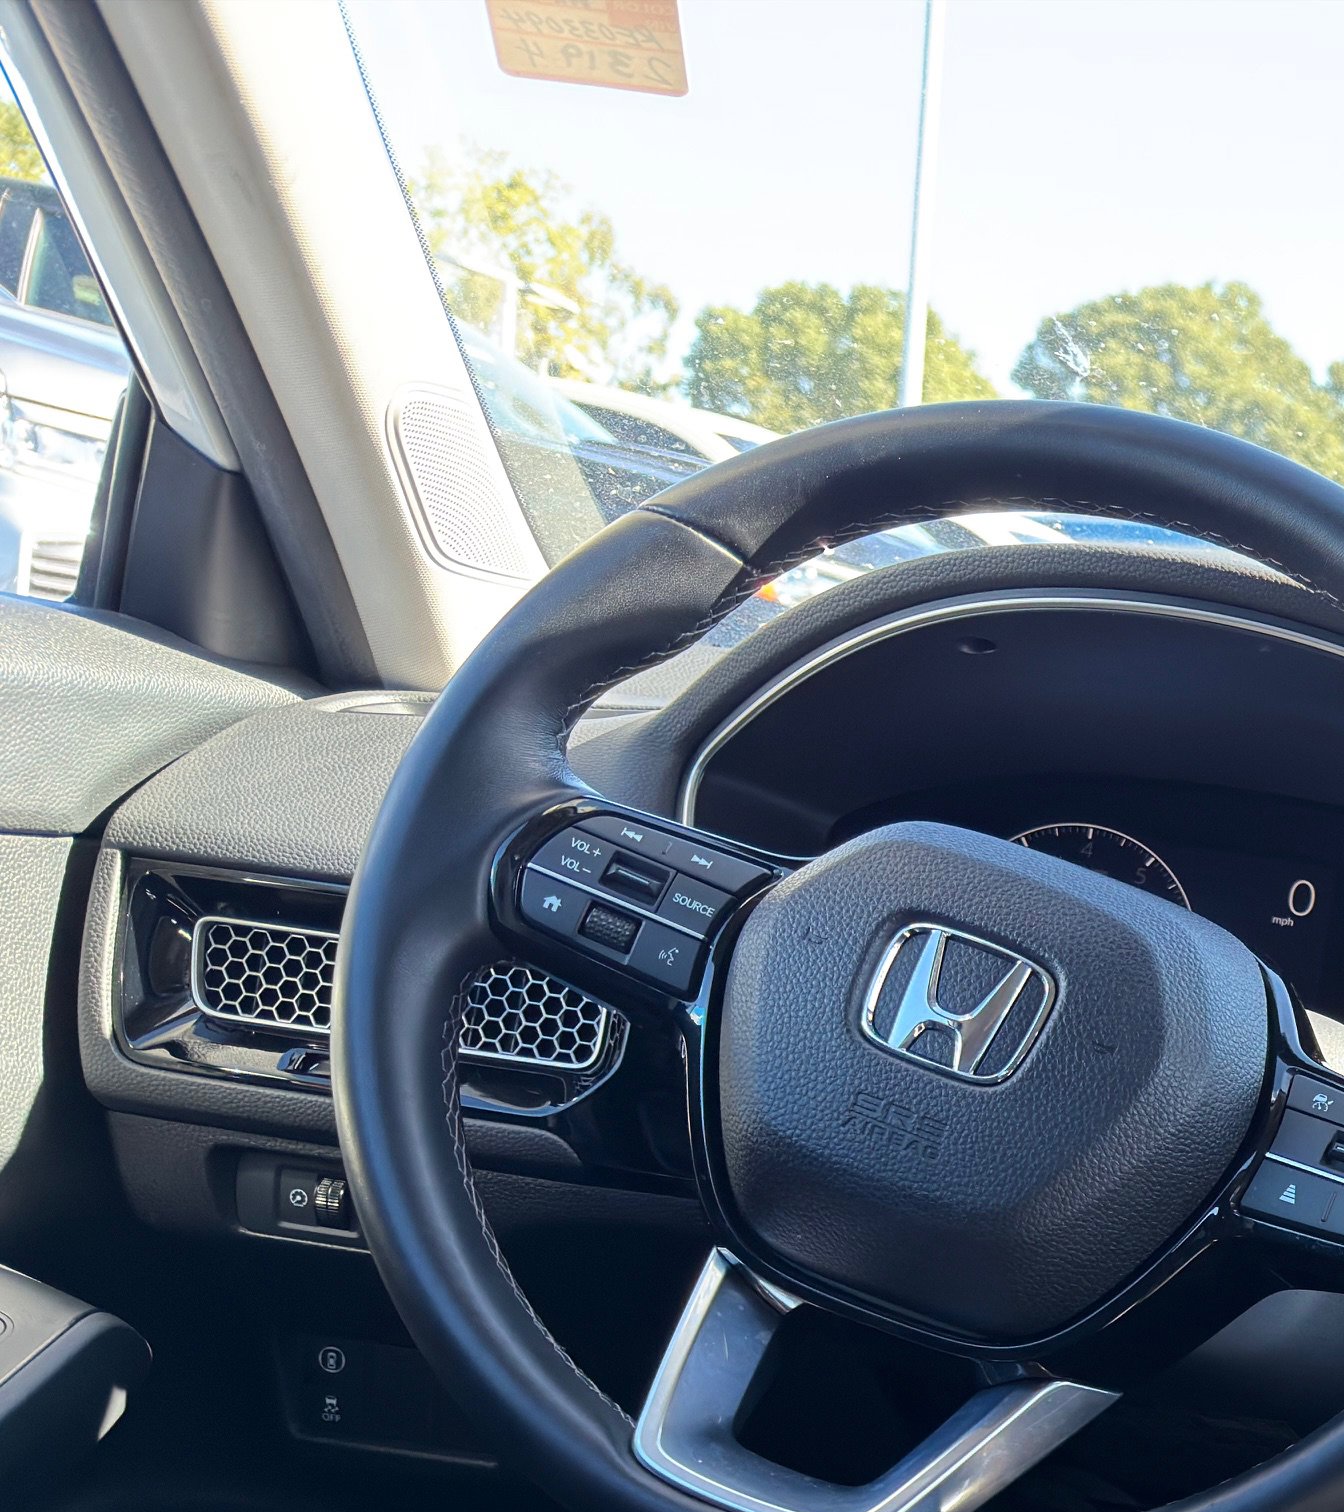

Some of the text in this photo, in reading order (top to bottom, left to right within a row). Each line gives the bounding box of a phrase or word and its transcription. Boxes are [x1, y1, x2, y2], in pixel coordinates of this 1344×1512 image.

[1080, 842, 1094, 859] 4
[1134, 867, 1147, 885] 5
[672, 892, 716, 918] SOURCE
[1288, 879, 1316, 917] 0
[1271, 915, 1295, 928] mph
